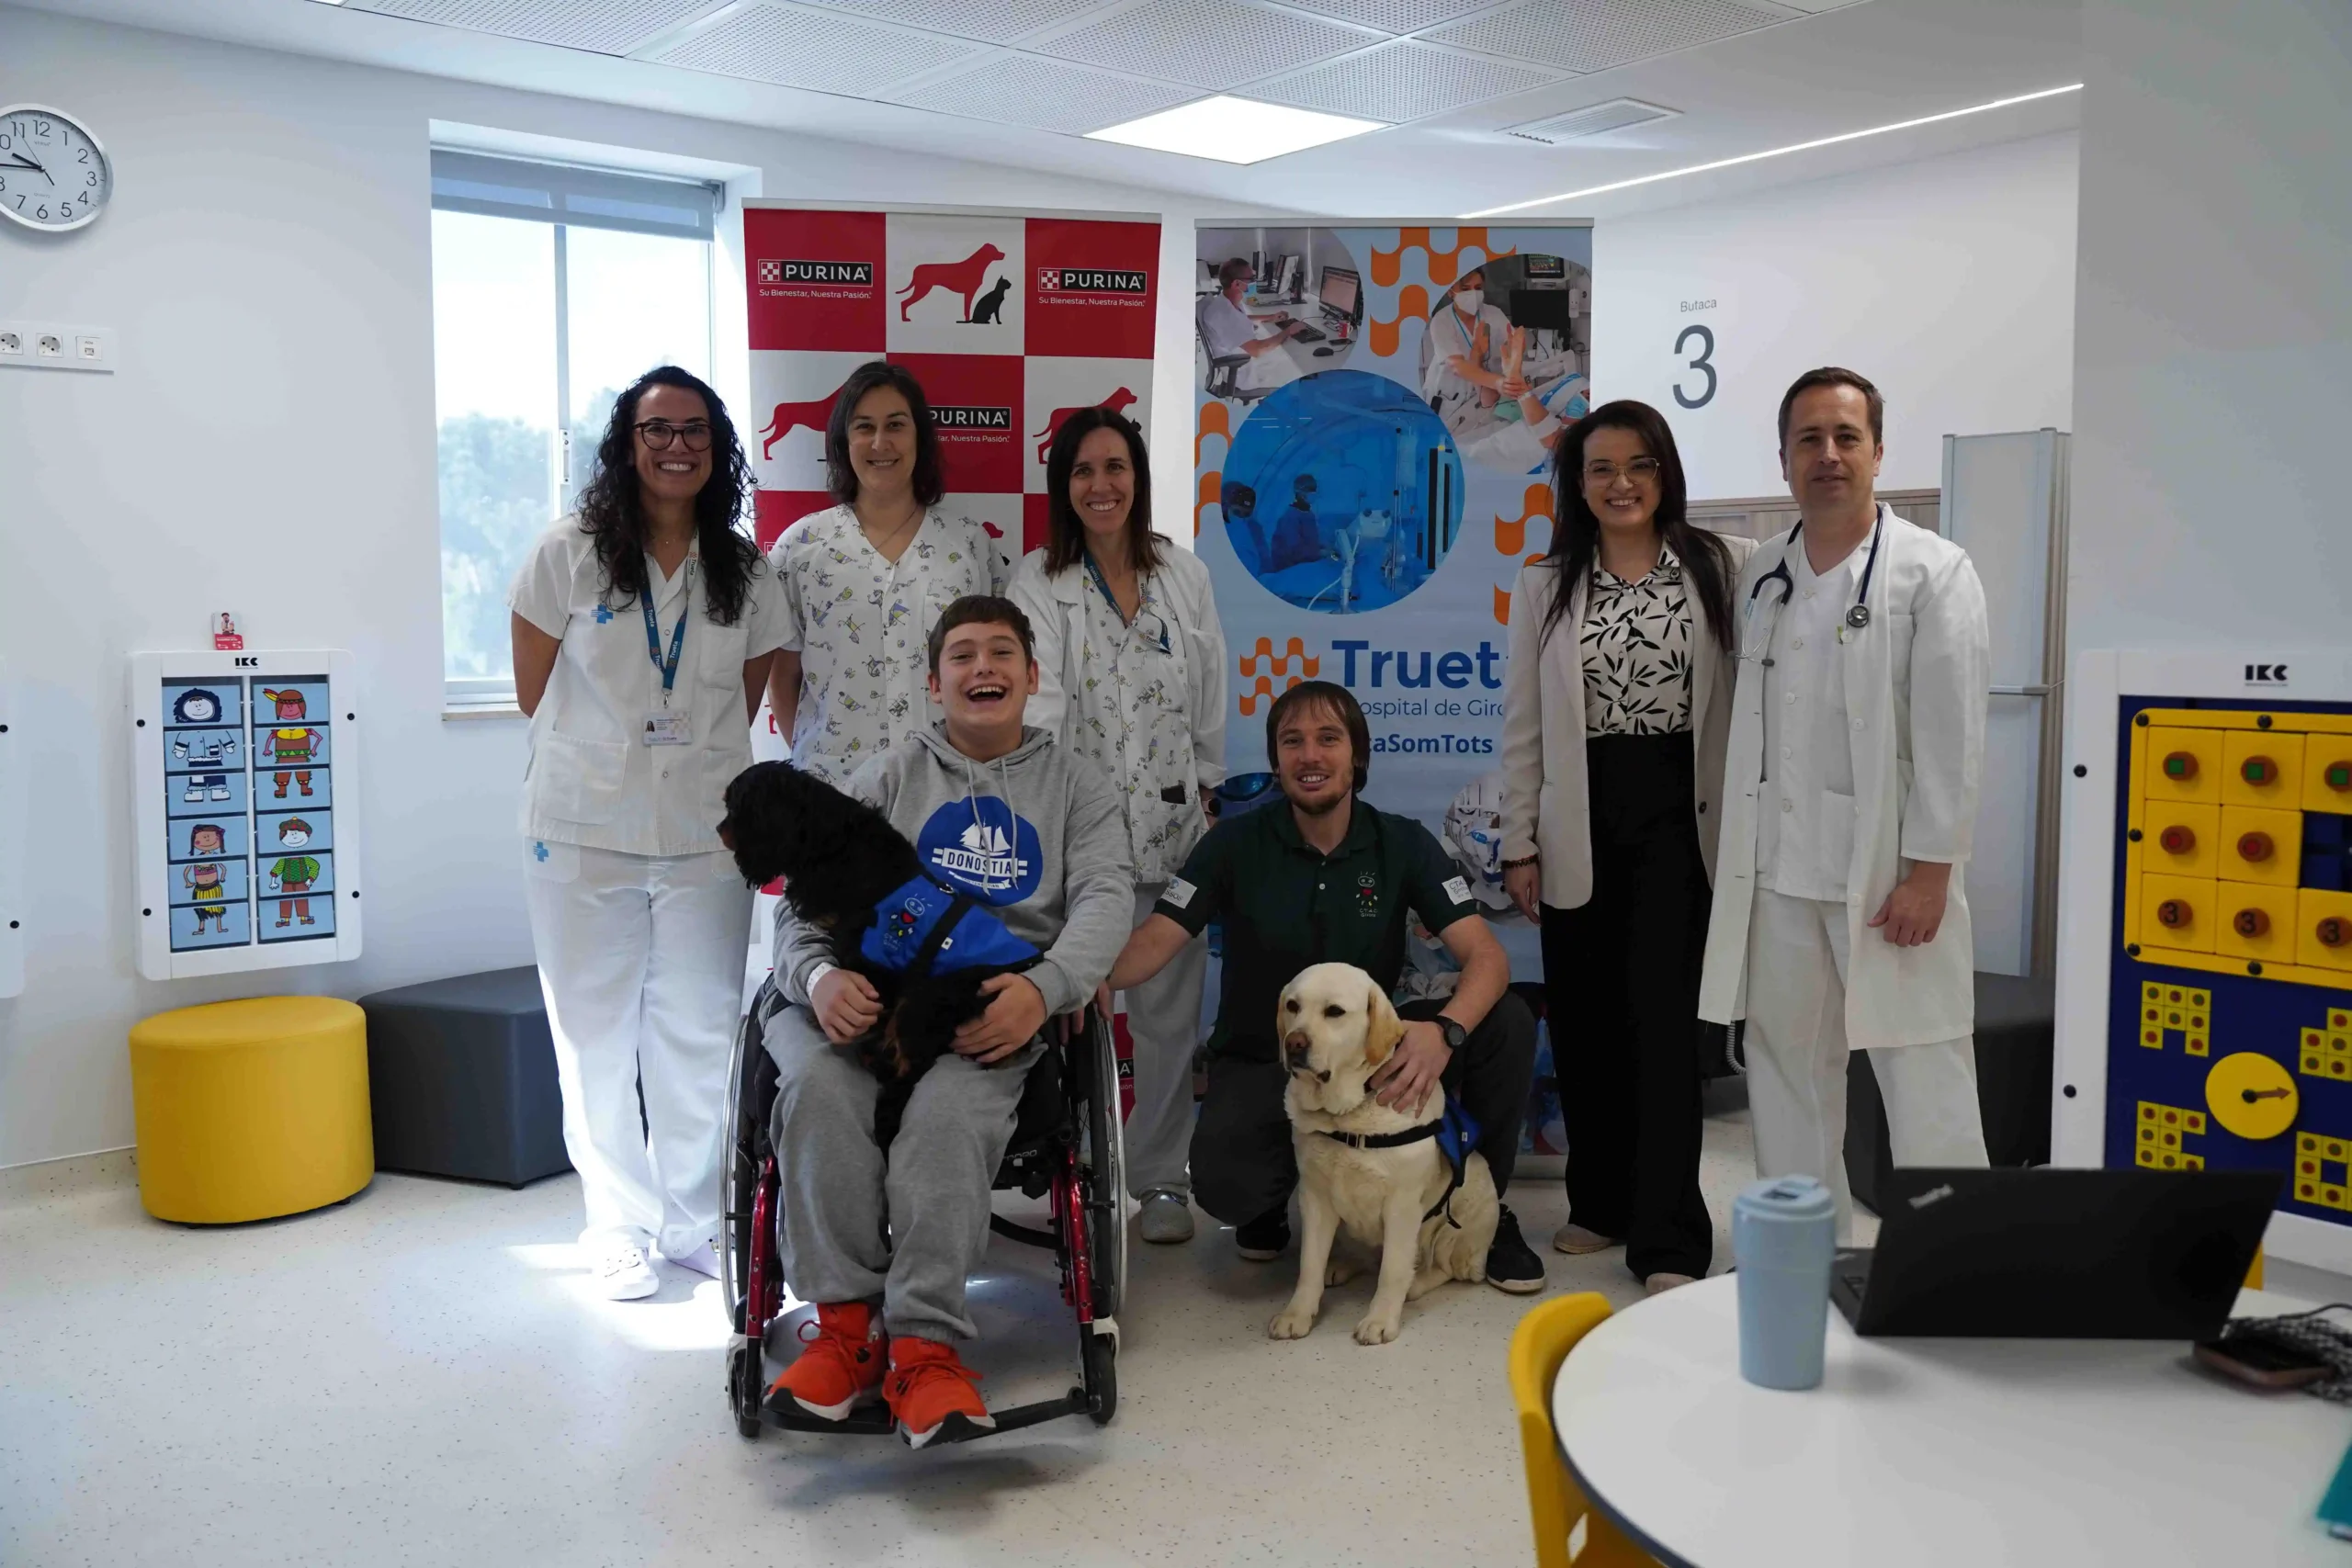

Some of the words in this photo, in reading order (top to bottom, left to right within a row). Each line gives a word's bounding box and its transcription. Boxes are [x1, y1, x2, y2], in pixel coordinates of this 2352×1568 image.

[11, 121, 25, 138] 11
[33, 119, 51, 137] 12
[0, 134, 11, 150] 0
[62, 130, 68, 146] 1
[77, 148, 88, 164] 2
[85, 171, 97, 186] 3
[17, 194, 26, 209] 7
[77, 190, 89, 205] 4
[37, 204, 49, 220] 6
[61, 202, 72, 218] 5
[759, 288, 770, 297] Su
[771, 288, 809, 299] Bienestar,
[810, 290, 842, 299] Nuestra
[1038, 296, 1049, 304] Su
[1050, 297, 1088, 306] Bienestar,
[1680, 299, 1717, 312] Butaca
[1672, 324, 1717, 409] 3
[1332, 640, 1509, 690] Truet
[1360, 698, 1428, 719] ospital
[1434, 698, 1462, 716] de
[1368, 734, 1494, 754] aSomTots
[2164, 901, 2179, 924] 3
[2240, 911, 2256, 934] 3
[2323, 919, 2340, 943] 3
